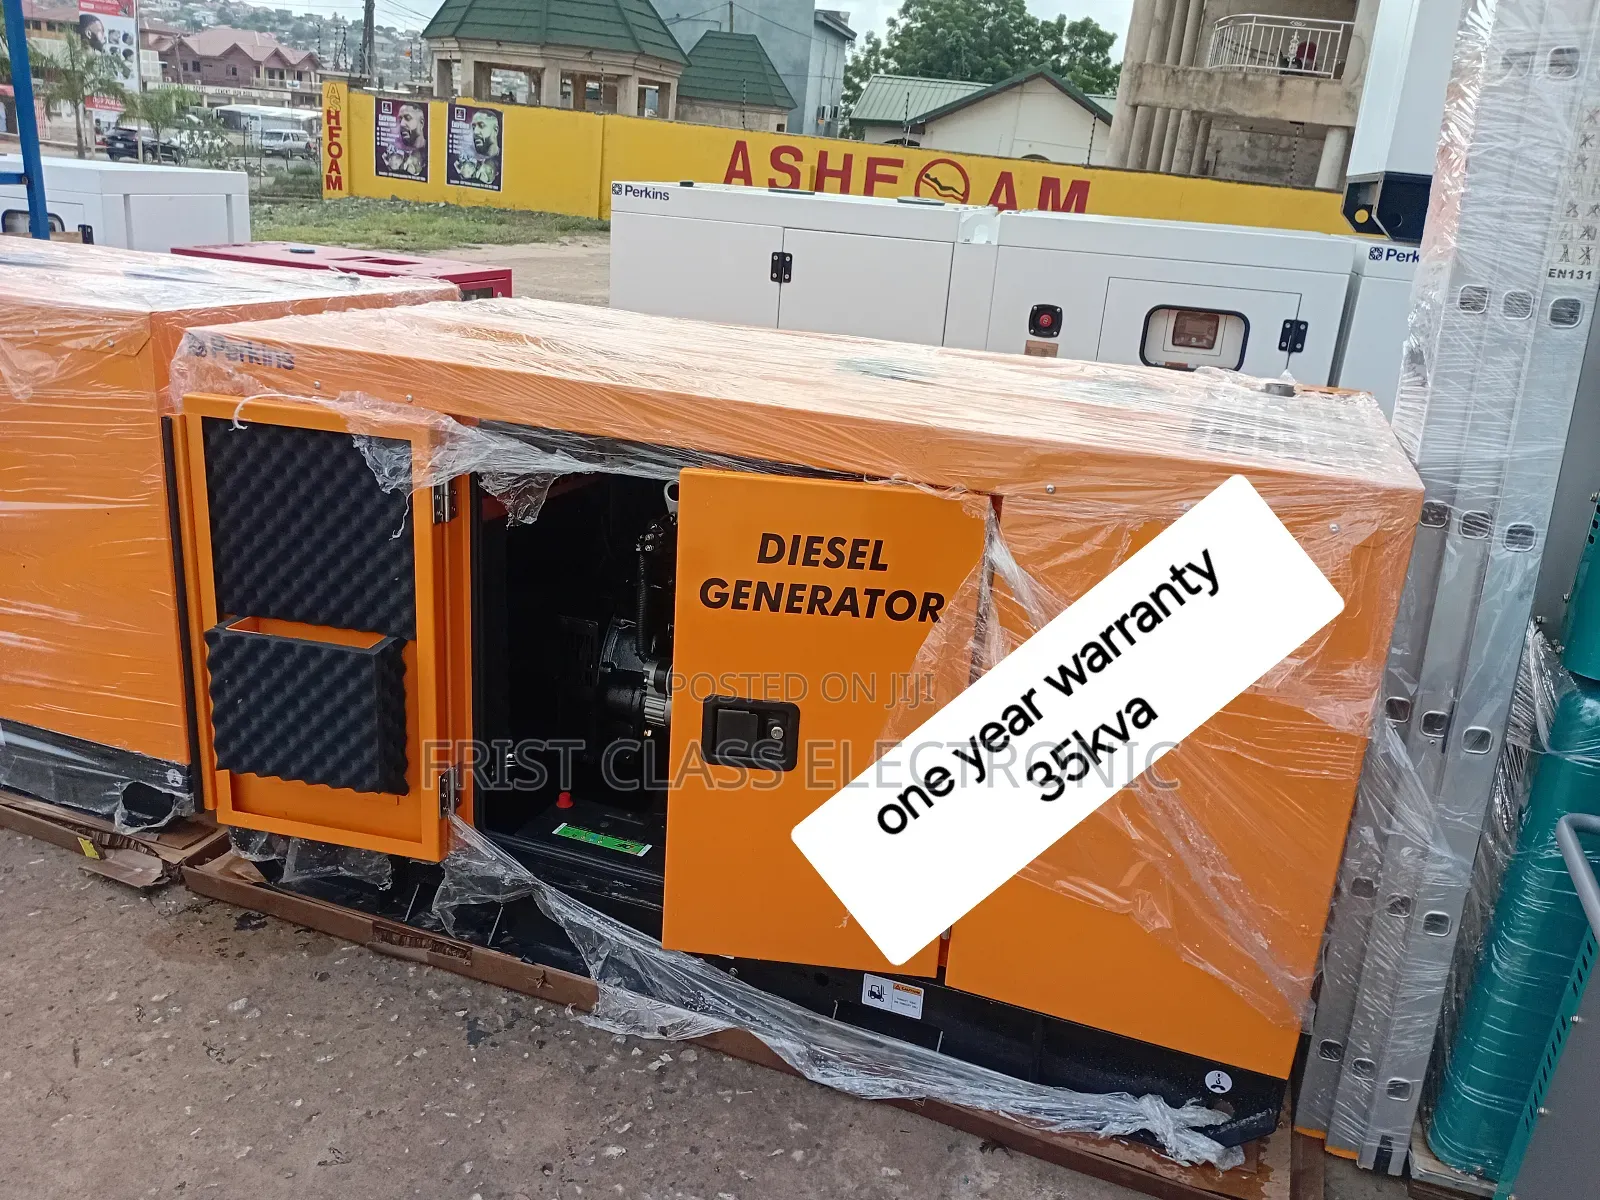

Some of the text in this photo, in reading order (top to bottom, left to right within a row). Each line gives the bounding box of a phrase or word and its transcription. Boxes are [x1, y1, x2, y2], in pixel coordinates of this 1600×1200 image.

[326, 83, 343, 191] ASHFOAM
[624, 184, 670, 201] Perkins
[1547, 268, 1592, 280] EN131
[757, 533, 889, 571] DIESEL
[700, 577, 945, 624] GENERATOR
